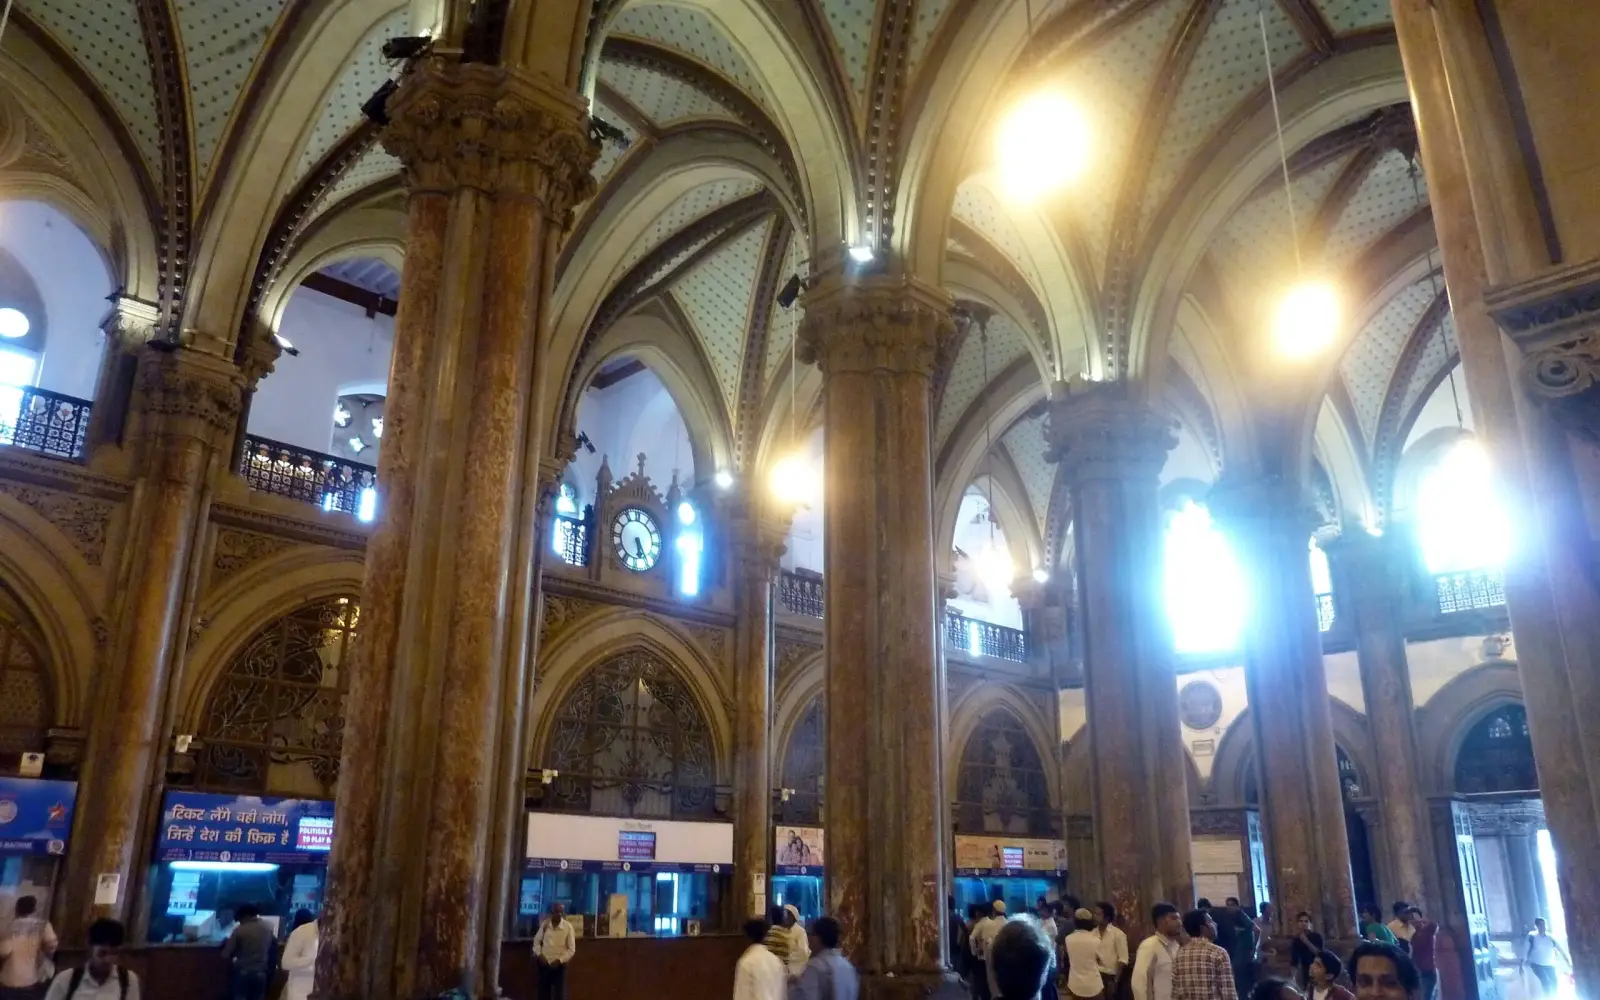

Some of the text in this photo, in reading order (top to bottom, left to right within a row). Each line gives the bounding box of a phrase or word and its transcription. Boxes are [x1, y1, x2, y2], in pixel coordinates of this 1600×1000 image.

[172, 804, 205, 821] टिकट
[210, 806, 231, 822] लेंगे
[236, 808, 257, 824] वही
[262, 811, 289, 827] लोग,
[167, 825, 196, 842] जिन्हें
[200, 826, 220, 842] देश
[225, 827, 242, 843] की
[281, 829, 290, 846] है
